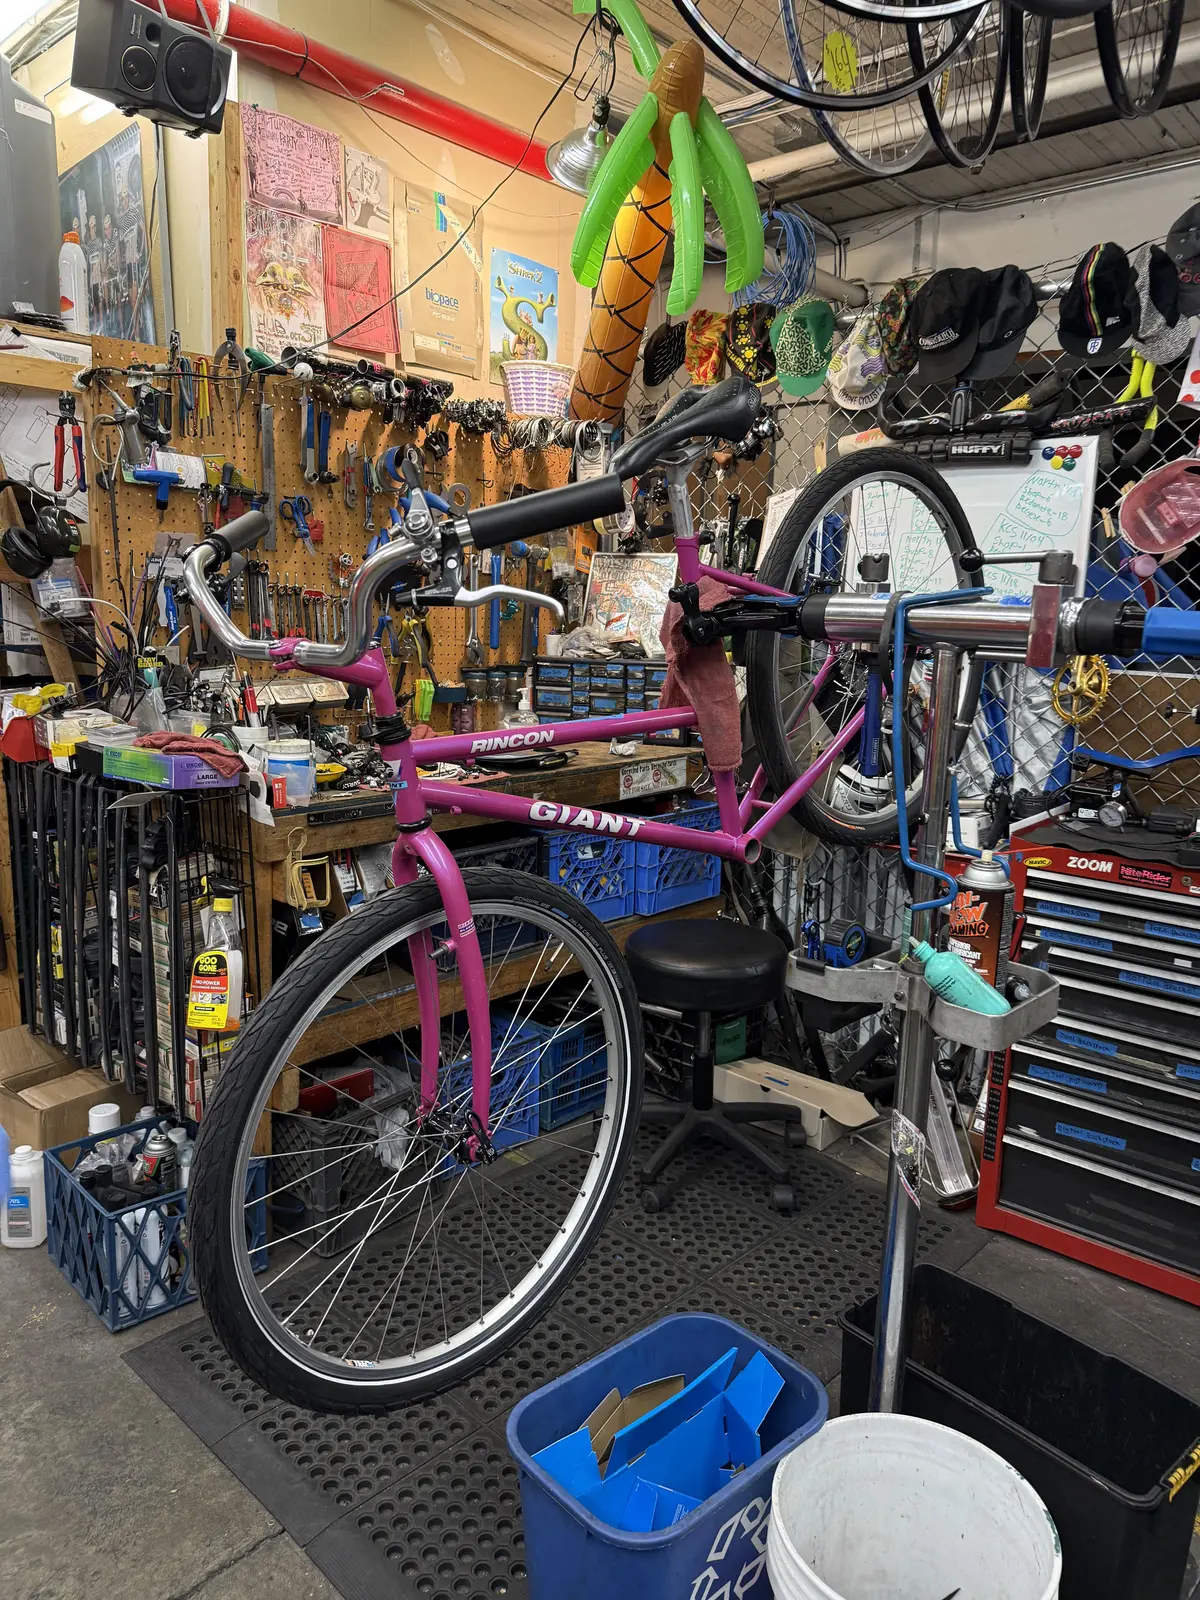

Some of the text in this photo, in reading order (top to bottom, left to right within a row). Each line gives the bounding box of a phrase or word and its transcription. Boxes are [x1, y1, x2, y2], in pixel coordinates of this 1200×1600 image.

[425, 287, 459, 309] biopace
[858, 389, 880, 406] CYCLIST
[951, 445, 1001, 454] HUFFY
[998, 518, 1045, 547] KCS 11/04
[470, 730, 555, 754] RINCON
[342, 780, 360, 789] SURLY
[529, 801, 645, 837] GIANT
[1067, 856, 1113, 873] ZOOM
[1120, 866, 1171, 882] NiteRider
